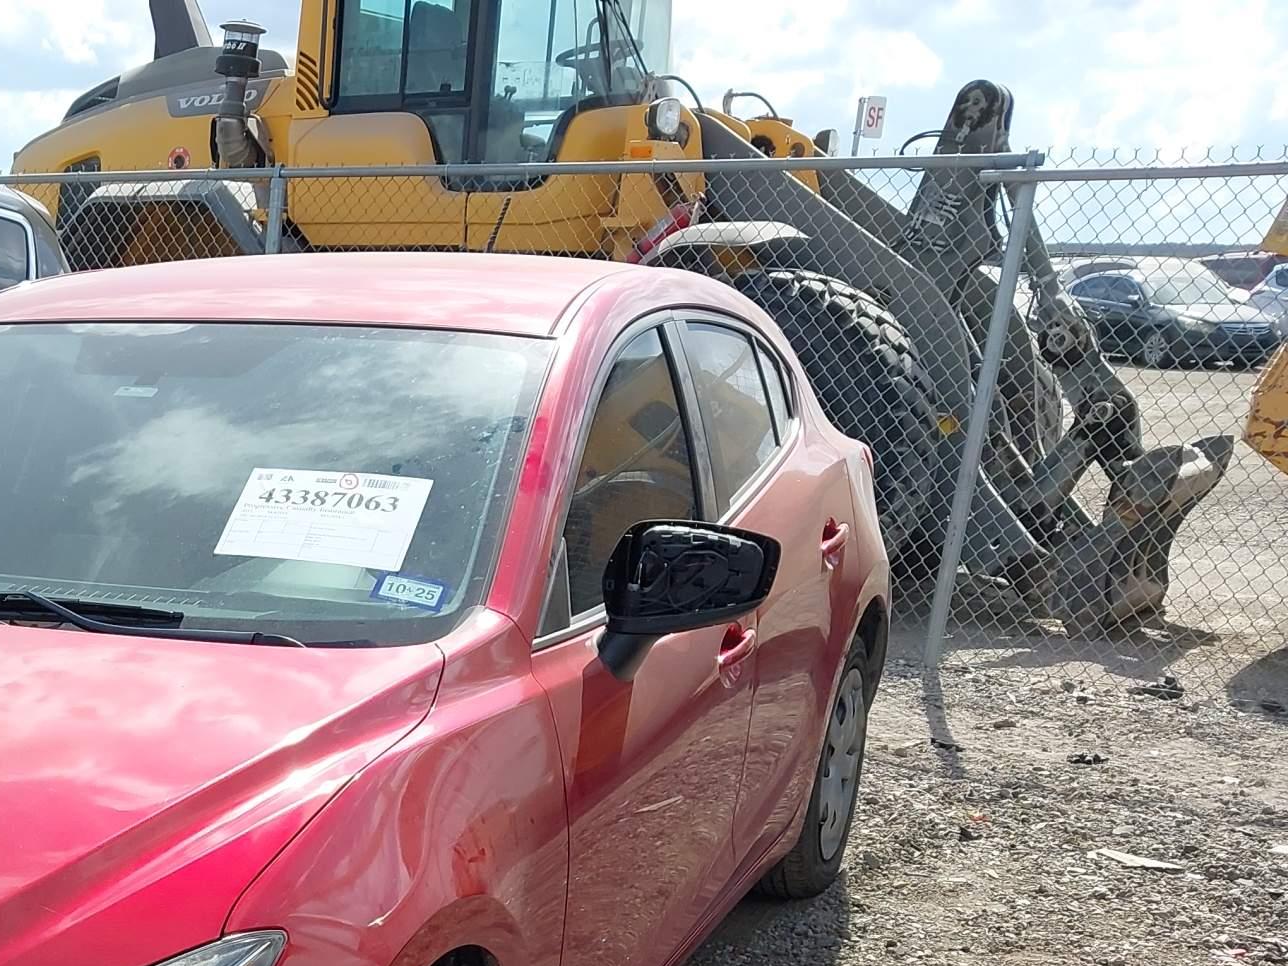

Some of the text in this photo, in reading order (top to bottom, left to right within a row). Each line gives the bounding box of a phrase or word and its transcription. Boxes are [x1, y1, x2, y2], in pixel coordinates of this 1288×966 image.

[178, 89, 257, 109] VOLO
[866, 106, 884, 128] SF
[258, 487, 400, 513] 43387063
[387, 581, 437, 601] 10 25
